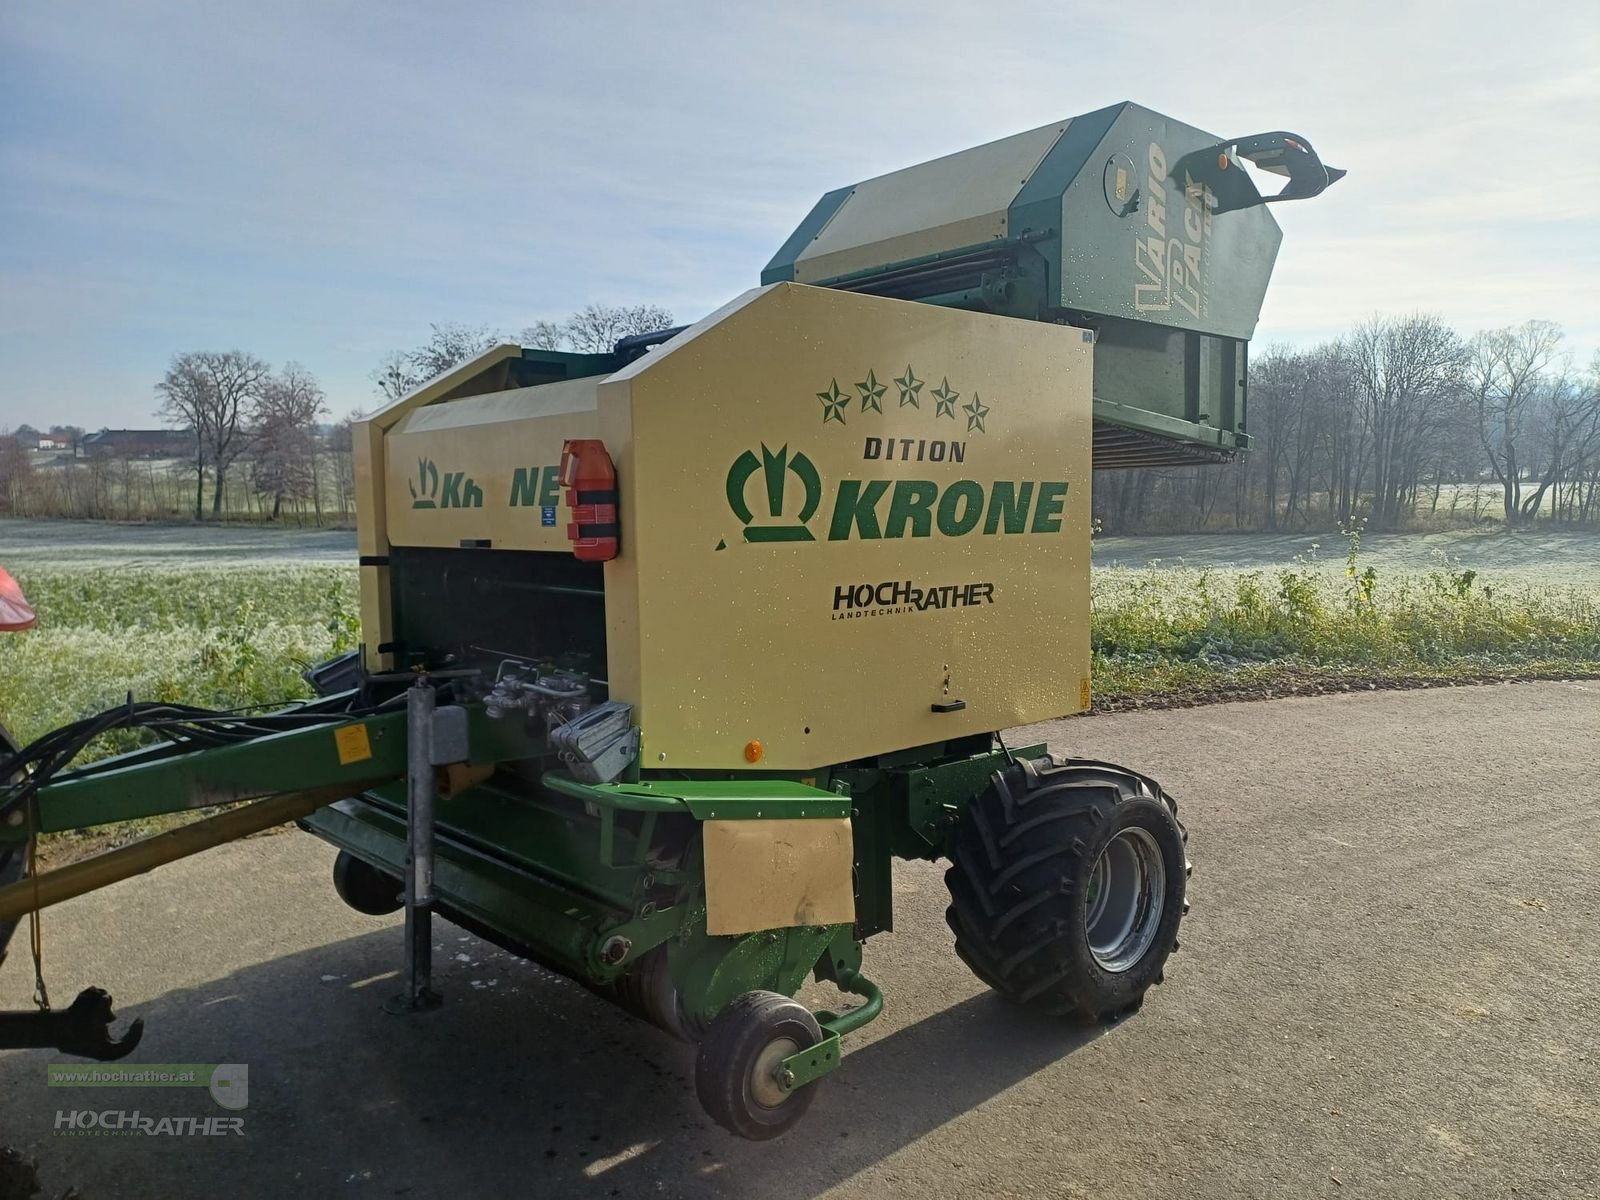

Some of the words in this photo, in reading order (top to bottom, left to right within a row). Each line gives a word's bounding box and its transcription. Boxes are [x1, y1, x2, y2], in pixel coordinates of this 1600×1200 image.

[1135, 142, 1170, 311] VARIO
[827, 479, 1069, 541] KRONE
[831, 605, 915, 621] LANDTECHNIK
[832, 581, 994, 611] HOCHRATHER
